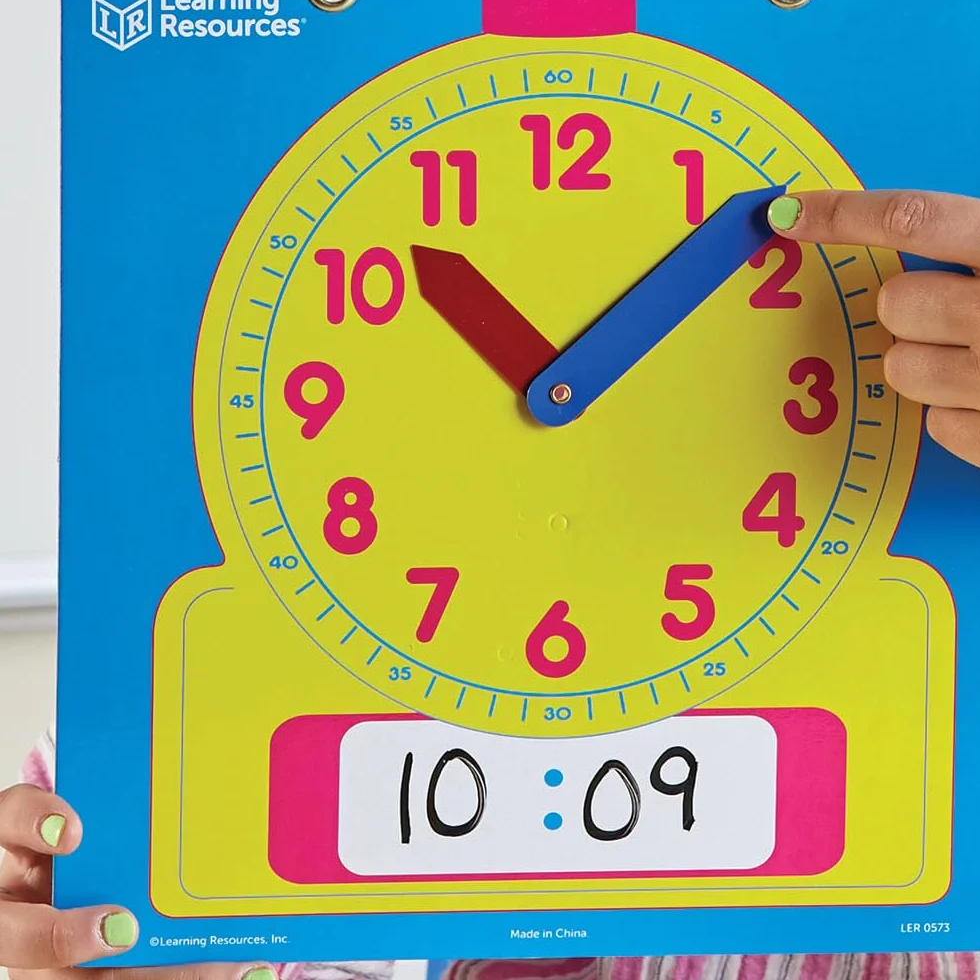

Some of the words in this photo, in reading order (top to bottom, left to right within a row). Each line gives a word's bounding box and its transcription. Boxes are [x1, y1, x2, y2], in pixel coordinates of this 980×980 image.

[544, 69, 573, 84] 60
[389, 116, 413, 131] 55
[710, 109, 723, 124] 5
[519, 112, 612, 191] 12
[409, 150, 477, 227] 11
[673, 149, 704, 226] 1
[269, 235, 298, 250] 50
[747, 234, 803, 309] 2
[314, 246, 405, 326] 10
[783, 356, 839, 435] 3
[865, 383, 885, 399] 15
[229, 394, 255, 409] 45
[283, 361, 345, 440] 9
[322, 476, 378, 555] 8
[742, 472, 805, 548] 4
[820, 540, 849, 555] 20
[268, 555, 299, 570] 40
[406, 567, 460, 643] 7
[661, 564, 716, 641] 5
[525, 599, 587, 678] 6
[388, 666, 412, 681] 35
[703, 662, 726, 677] 25
[543, 707, 572, 721] 30
[510, 929, 540, 939] Made
[542, 929, 553, 939] in
[555, 927, 588, 939] China
[900, 923, 921, 933] LER
[923, 922, 951, 933] 0573
[271, 933, 291, 944] Inc.
